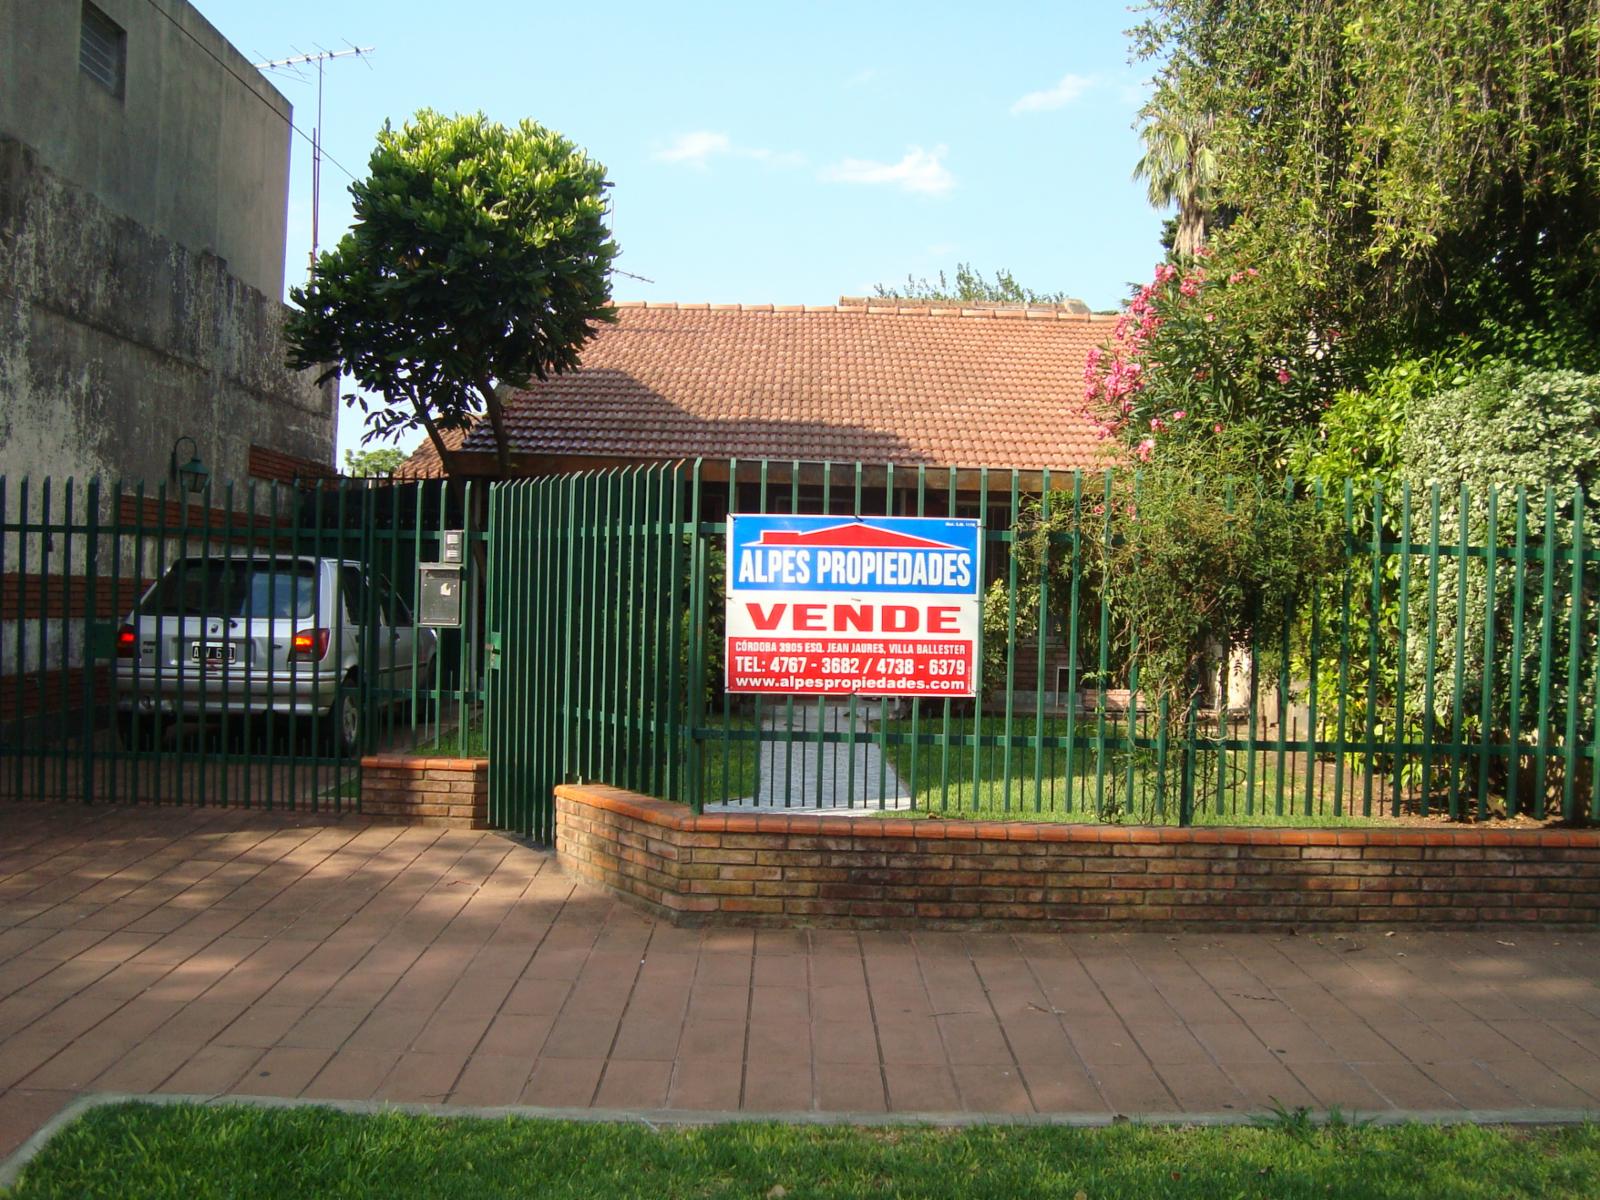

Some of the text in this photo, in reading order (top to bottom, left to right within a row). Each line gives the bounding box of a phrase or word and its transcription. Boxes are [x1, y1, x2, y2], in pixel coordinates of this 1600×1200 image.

[739, 549, 971, 587] ALPES PROPIEDADES
[746, 603, 961, 634] VENDE
[735, 640, 965, 655] CÓRDOBA 3905 ESQ. JEAN JAURES, VILLA BALLESTER
[735, 656, 766, 673] TEL:
[770, 656, 807, 673] 4767
[821, 657, 859, 674] 3682
[863, 658, 873, 674] /
[876, 658, 914, 675] 4738
[928, 659, 966, 676] 6379
[736, 676, 965, 691] www.alpespropiedades.com
